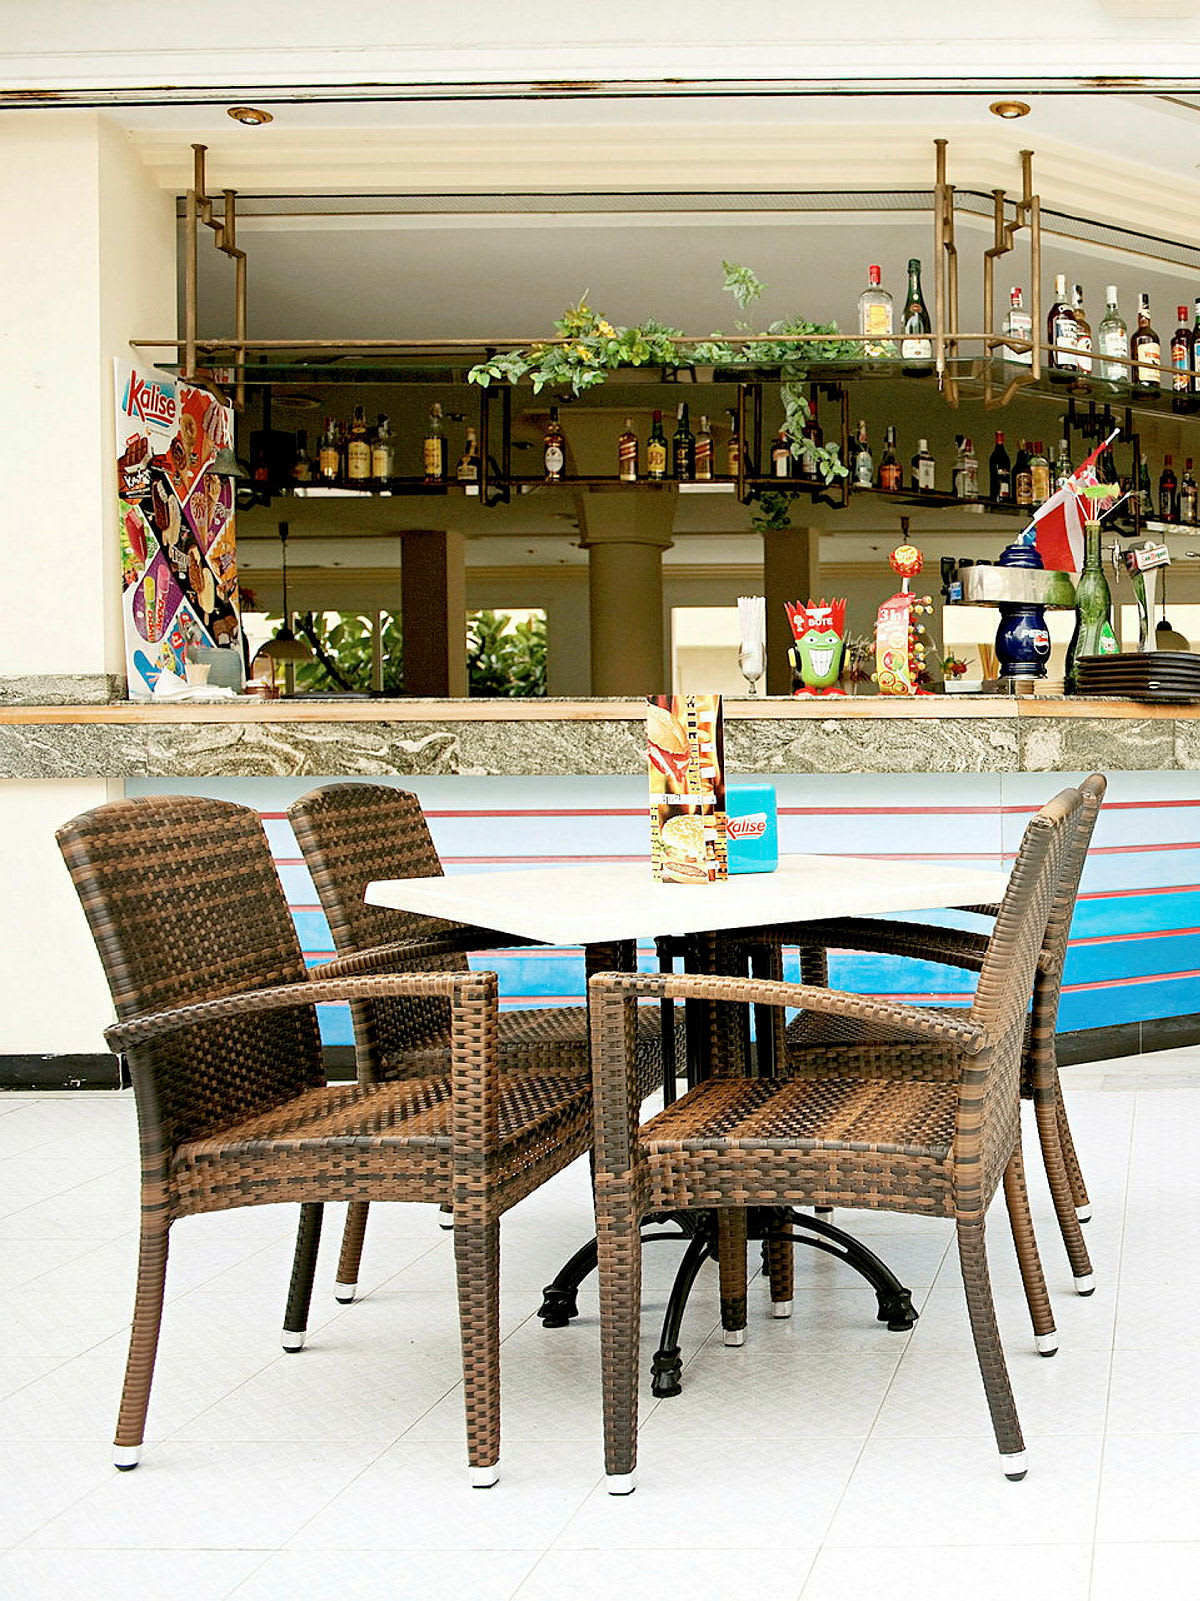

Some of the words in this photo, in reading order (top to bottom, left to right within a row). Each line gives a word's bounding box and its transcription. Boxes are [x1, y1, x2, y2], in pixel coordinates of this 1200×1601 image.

[127, 370, 176, 422] Kalise
[808, 617, 833, 627] BOTE
[1021, 628, 1049, 639] PEPS
[726, 817, 766, 840] Kalise
